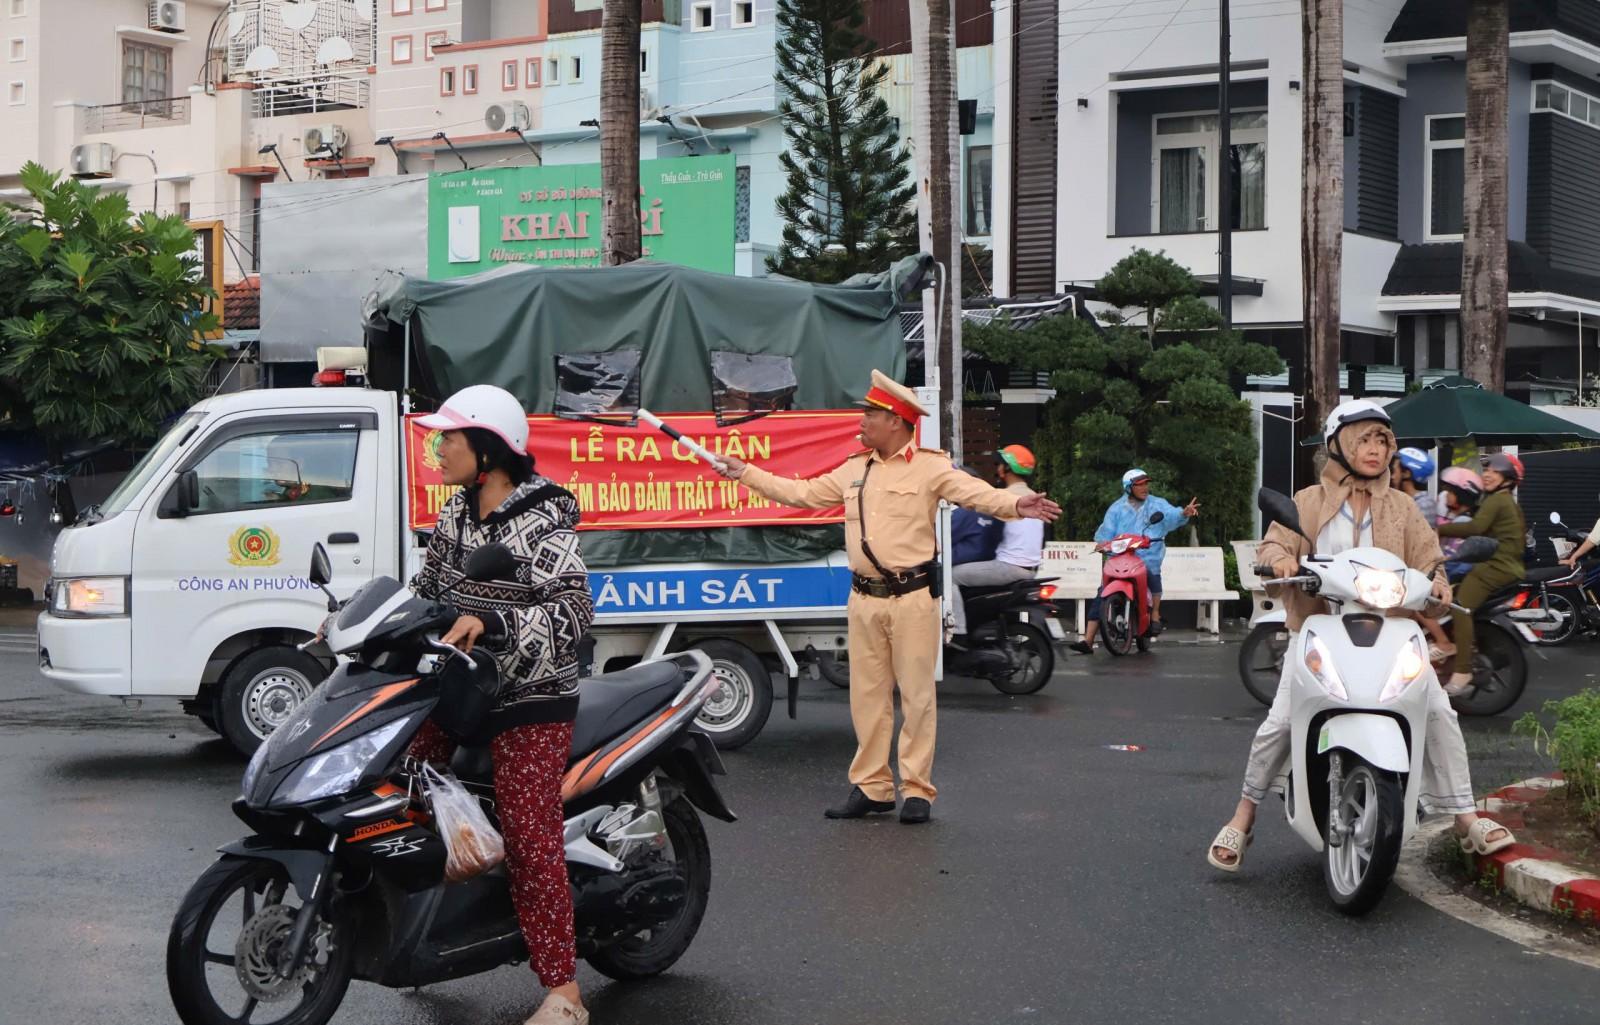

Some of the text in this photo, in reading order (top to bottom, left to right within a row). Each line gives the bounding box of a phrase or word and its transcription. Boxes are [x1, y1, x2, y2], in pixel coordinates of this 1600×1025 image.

[501, 211, 590, 242] KHAI
[570, 425, 605, 462] LỄ
[616, 436, 663, 462] RA
[598, 472, 631, 512] BẢO
[634, 471, 672, 512] ĐẢM
[675, 474, 714, 517] TRẬT
[178, 576, 224, 591] CÔNG
[227, 578, 249, 590] AN
[595, 572, 784, 607] ẢNH SÁT
[356, 820, 398, 836] HONDA
